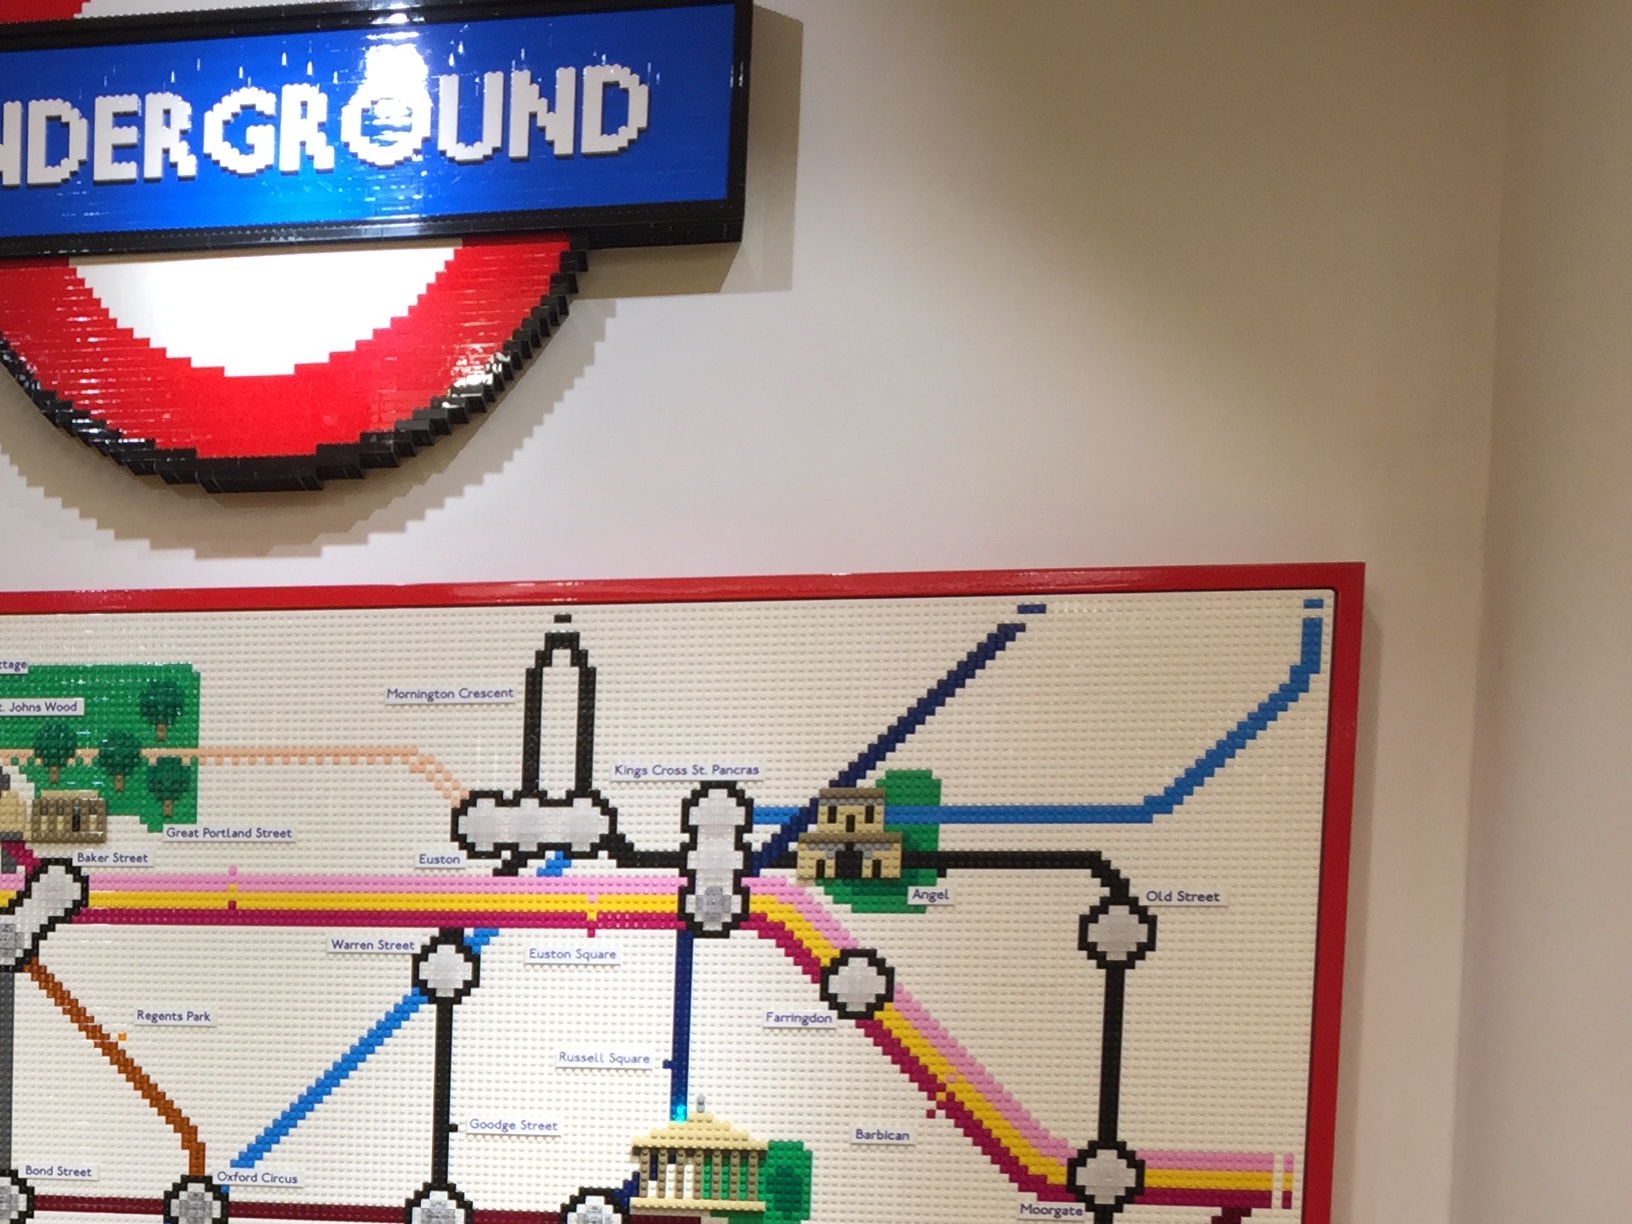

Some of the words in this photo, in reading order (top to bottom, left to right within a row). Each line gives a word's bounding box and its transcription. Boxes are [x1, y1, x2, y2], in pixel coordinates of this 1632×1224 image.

[387, 689, 454, 703] Mornington
[458, 687, 514, 700] Crescent
[10, 702, 40, 713] Johns
[44, 701, 77, 713] Wood
[615, 764, 648, 778] Kings
[652, 765, 687, 776] Cross
[692, 764, 708, 776] St.
[712, 764, 759, 776] Pancras
[166, 827, 198, 839] Great
[203, 827, 251, 839] Portland
[255, 827, 292, 839] Street
[78, 852, 109, 863] Baker
[113, 852, 148, 863] Street
[419, 854, 460, 865] Euston
[912, 889, 949, 903] Angel
[1146, 890, 1172, 902] Old
[1177, 891, 1220, 903] Street
[331, 940, 373, 951] Warren
[378, 940, 415, 951] Street
[530, 949, 570, 960] Euston
[576, 949, 616, 963] Square
[137, 1010, 183, 1024] Regents
[187, 1011, 211, 1022] Park
[766, 1012, 832, 1026] Farringdon
[559, 1052, 604, 1064] Russell
[609, 1053, 650, 1068] Square
[470, 1119, 515, 1133] Goodge
[520, 1120, 558, 1132] Street
[856, 1129, 909, 1141] Barbican
[25, 1165, 53, 1177] Bond
[57, 1166, 92, 1177] Street
[217, 1171, 258, 1183] Oxford
[261, 1173, 298, 1184] Circus
[1020, 1204, 1083, 1219] Moorgate
